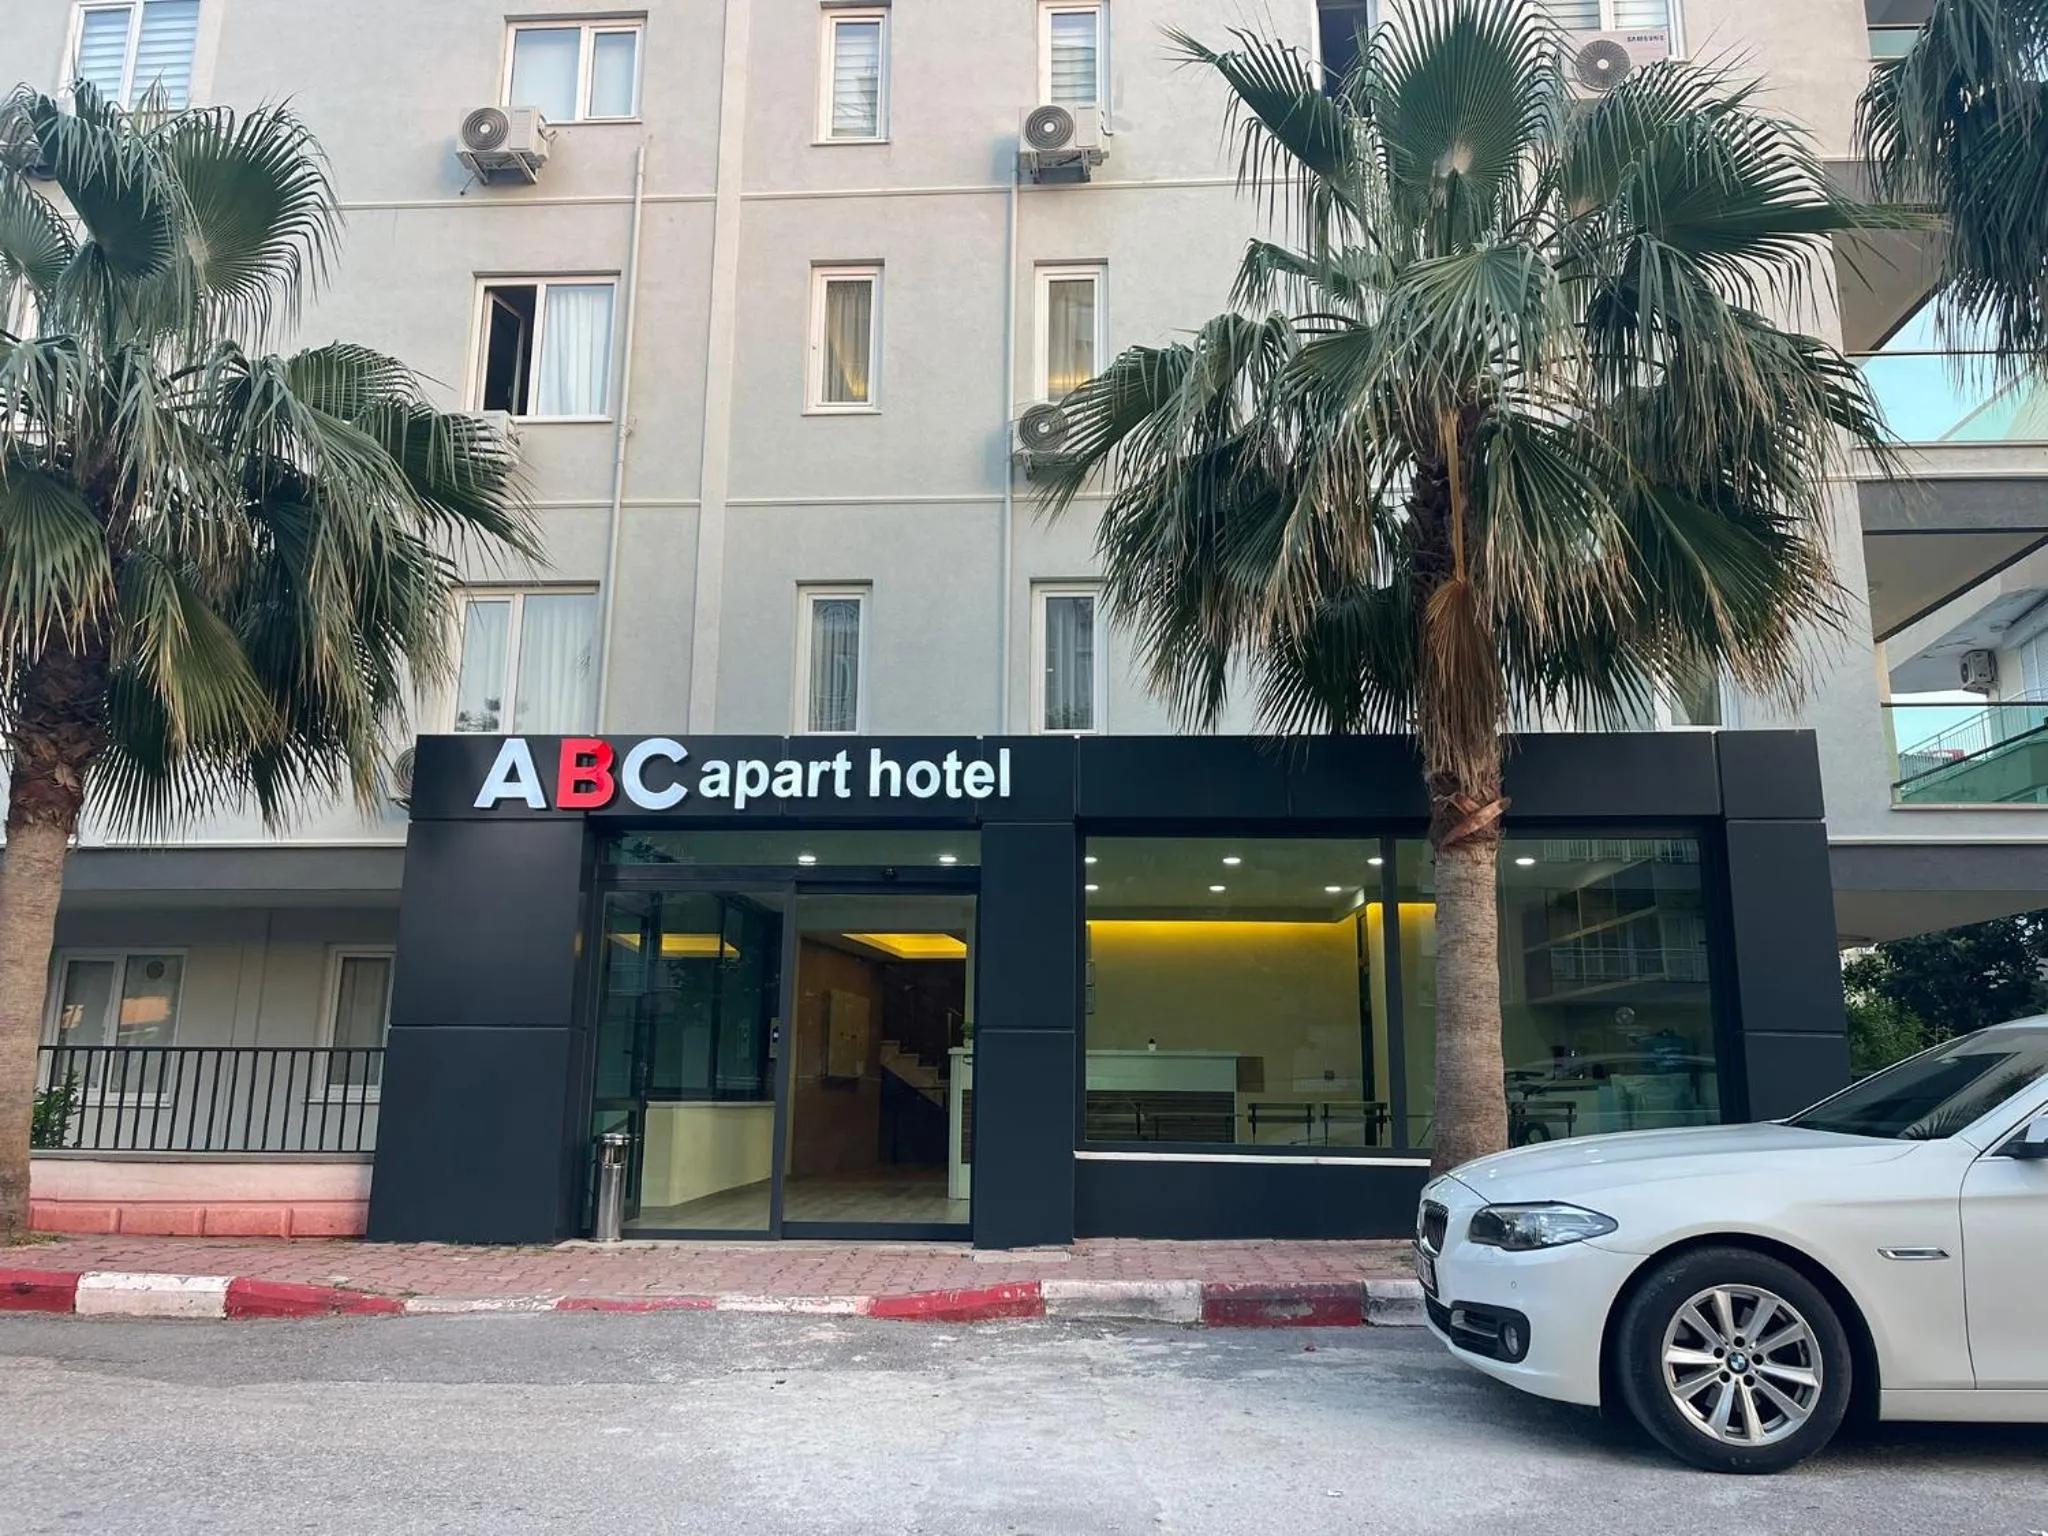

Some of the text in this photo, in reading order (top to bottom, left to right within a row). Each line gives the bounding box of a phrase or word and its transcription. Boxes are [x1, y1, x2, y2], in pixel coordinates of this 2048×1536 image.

[473, 737, 1011, 811] ABC apart hotel
